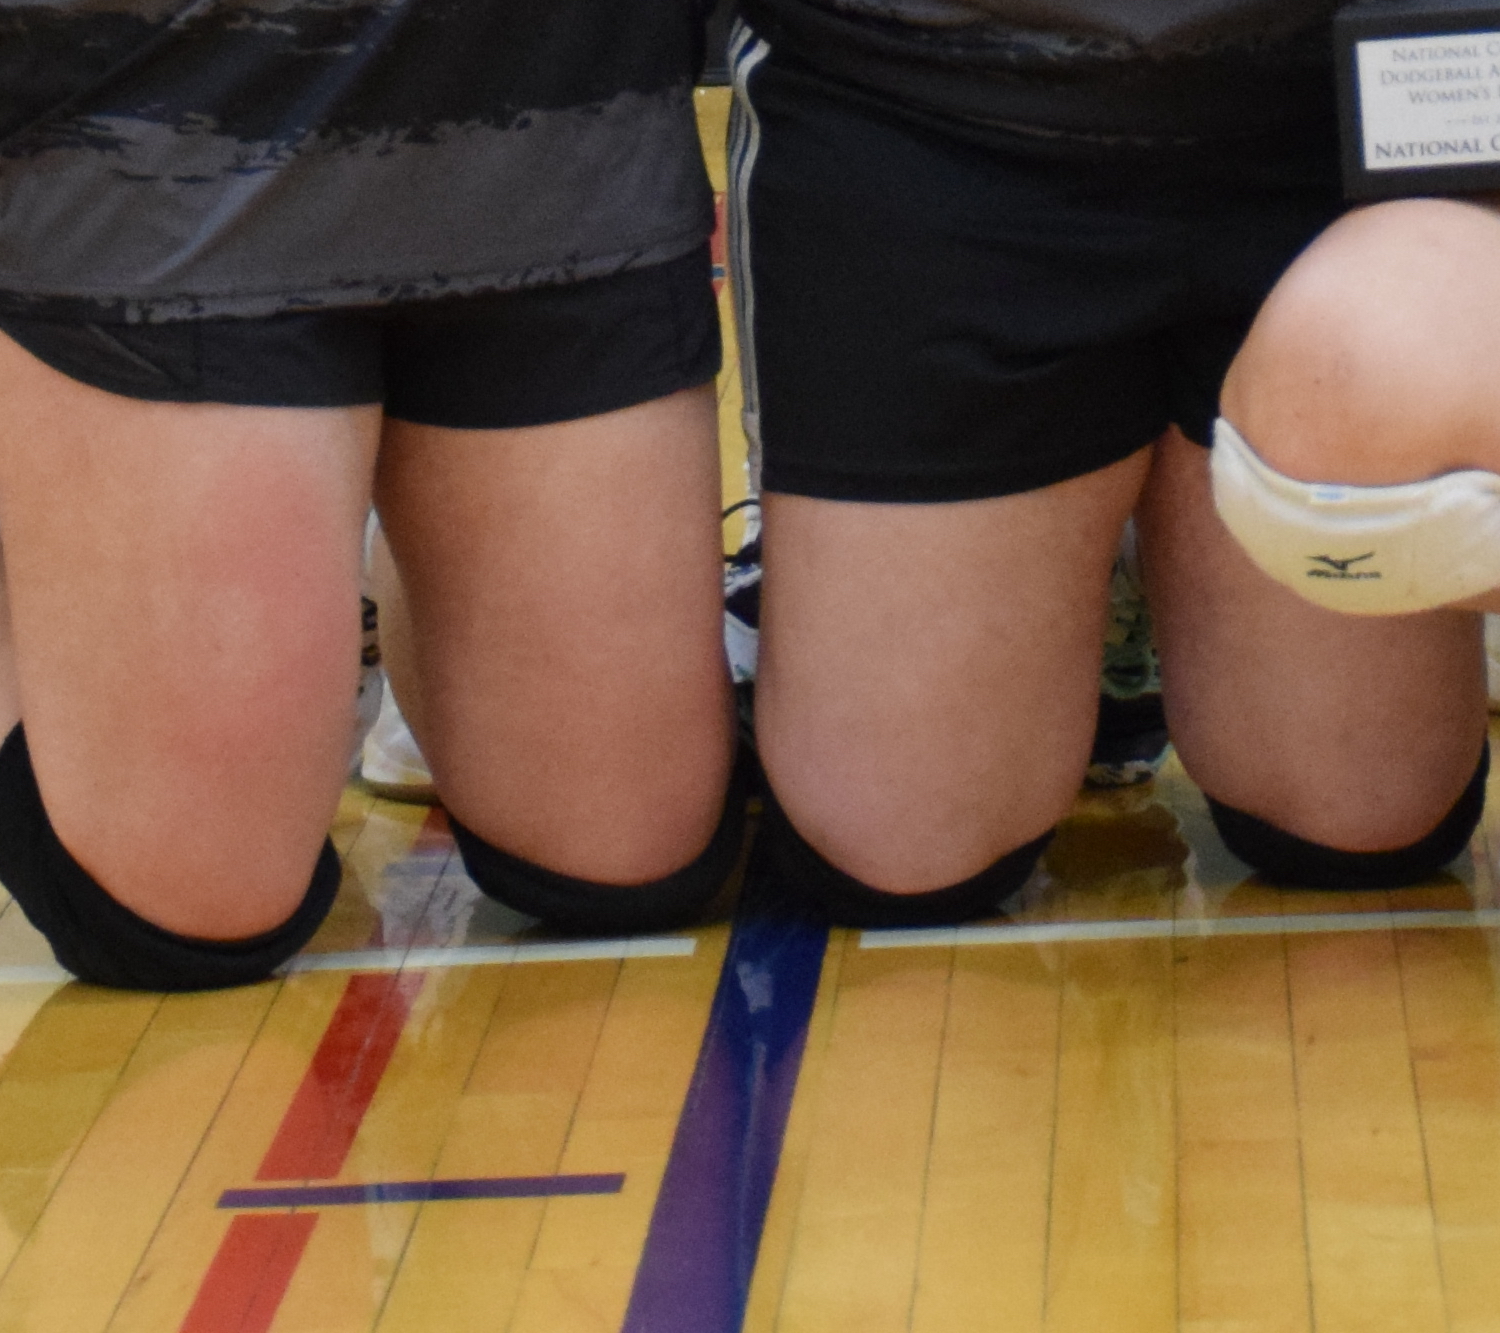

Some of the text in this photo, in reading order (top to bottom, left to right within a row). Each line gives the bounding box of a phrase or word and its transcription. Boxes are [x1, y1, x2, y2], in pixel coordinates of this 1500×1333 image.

[1392, 46, 1478, 63] NATIONAL
[1380, 66, 1482, 85] DODGEBALL
[1375, 139, 1483, 160] NATIONAL
